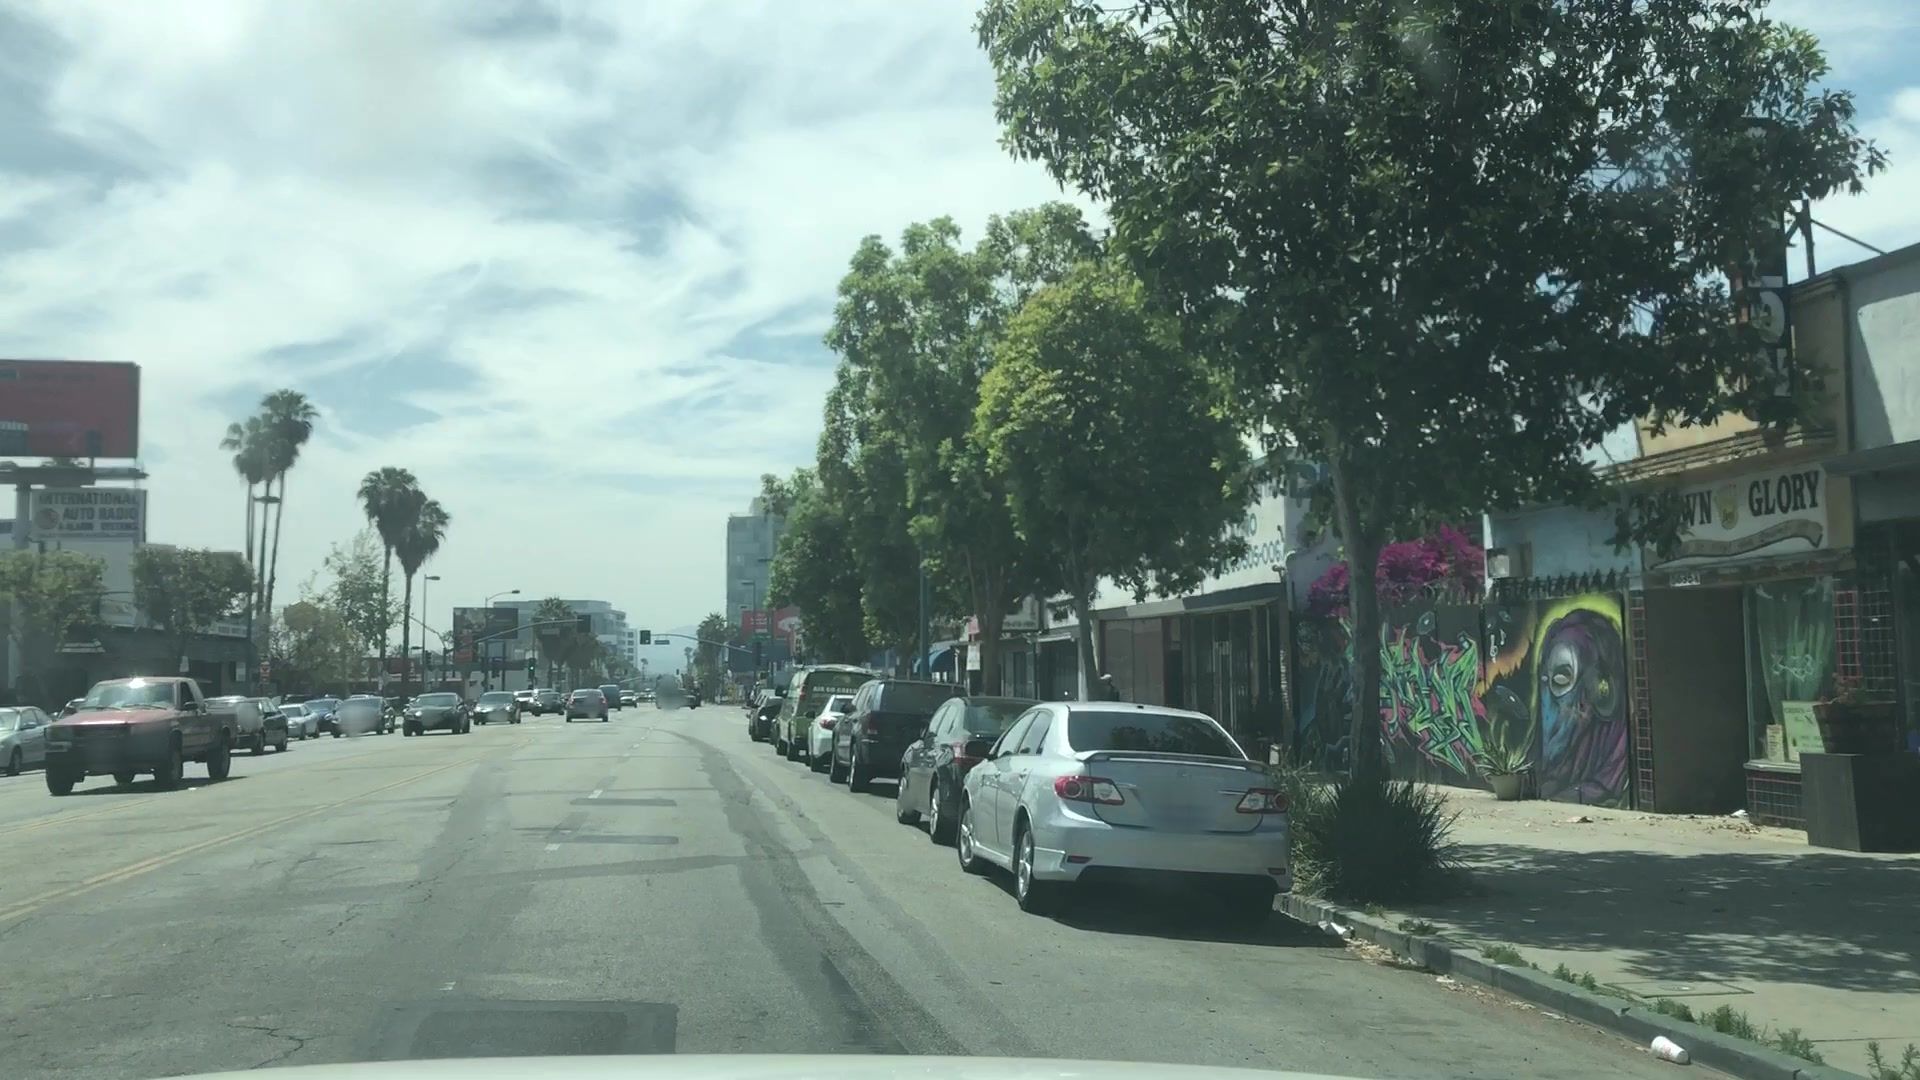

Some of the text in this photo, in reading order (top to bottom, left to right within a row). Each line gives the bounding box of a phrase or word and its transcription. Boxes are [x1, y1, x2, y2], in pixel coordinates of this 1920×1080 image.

[38, 491, 139, 505] INTERNATIONAL
[1748, 469, 1820, 517] GLORY
[63, 507, 95, 520] AUTO
